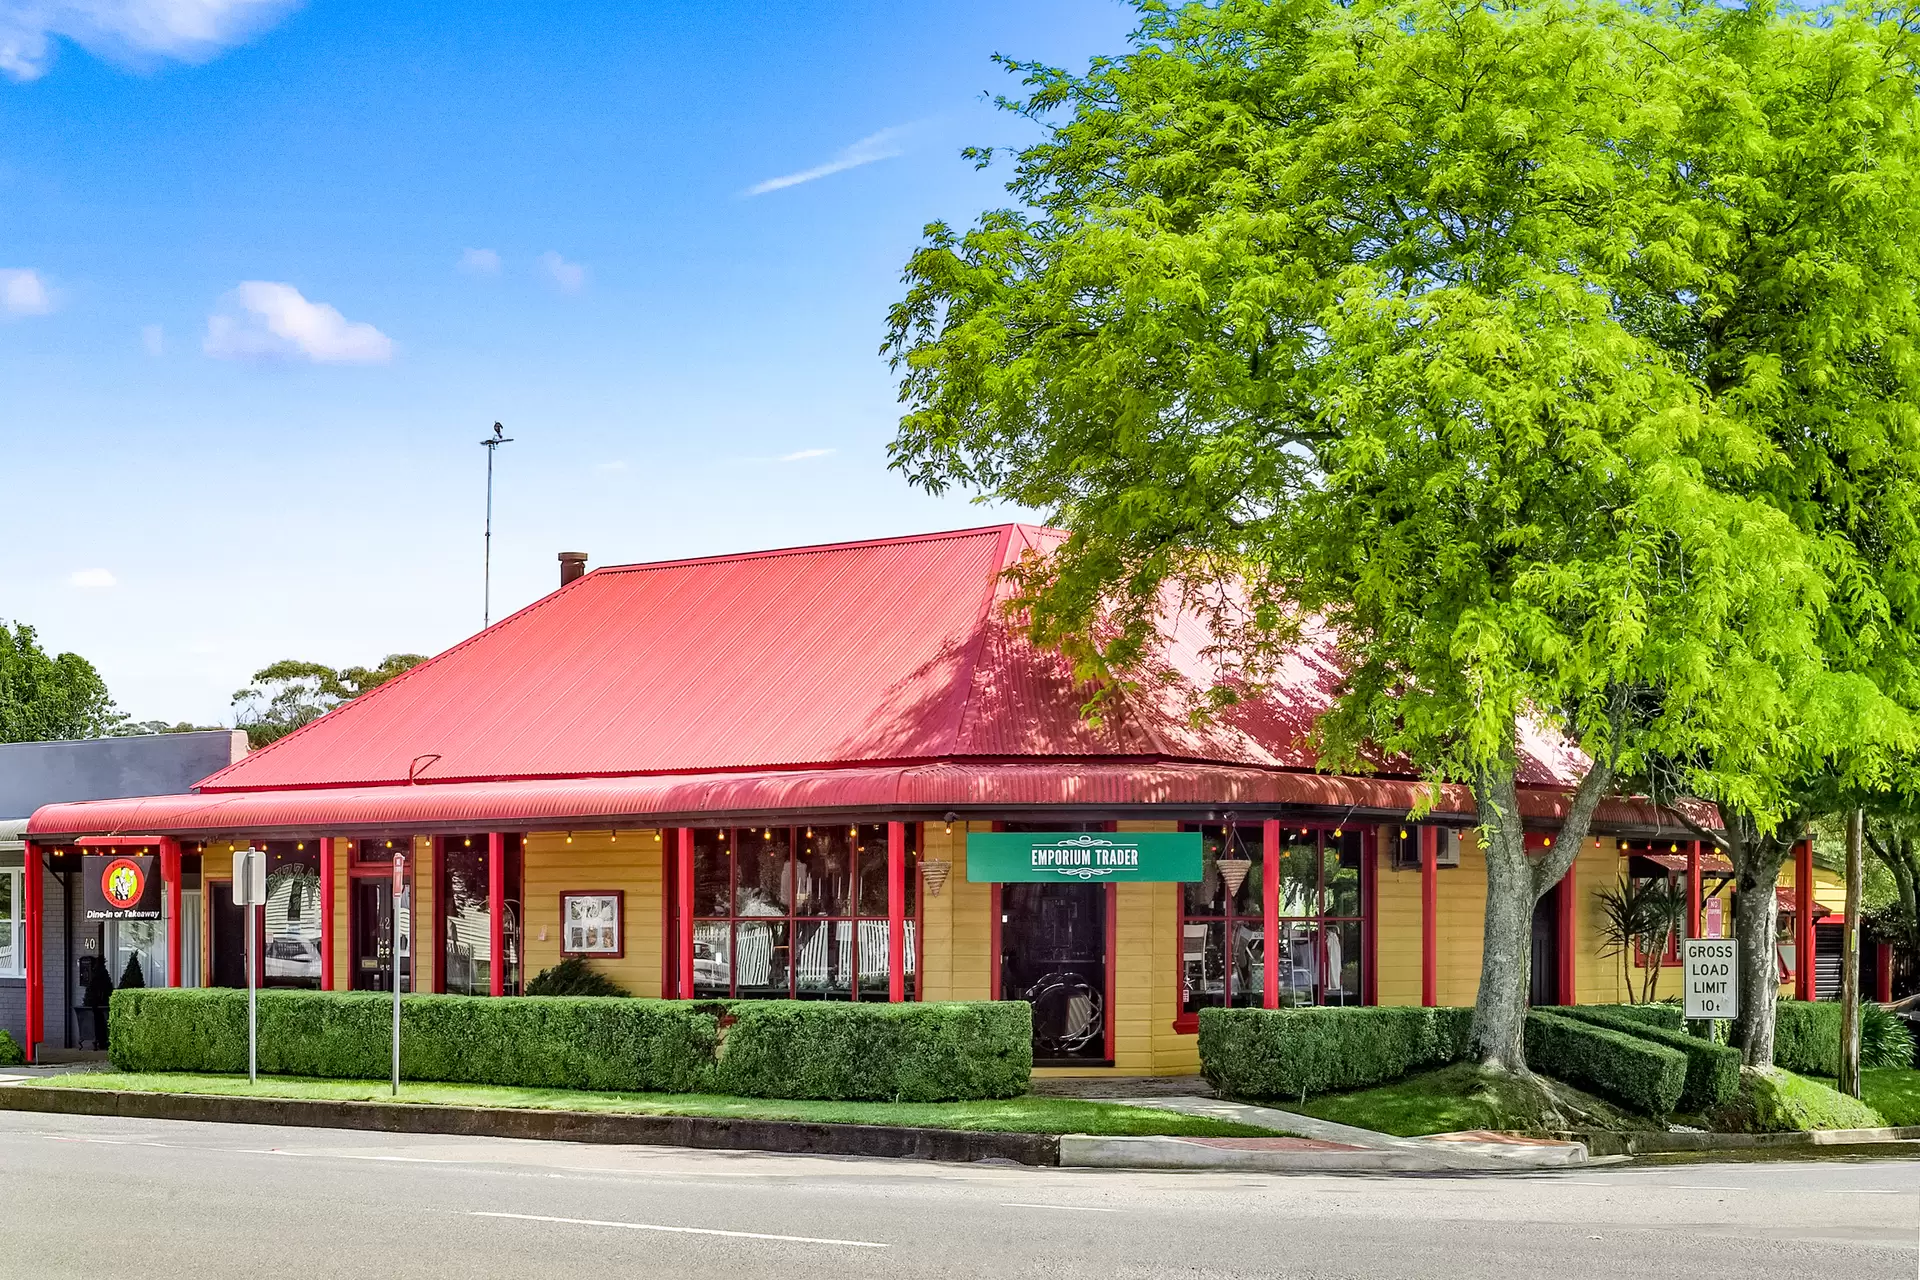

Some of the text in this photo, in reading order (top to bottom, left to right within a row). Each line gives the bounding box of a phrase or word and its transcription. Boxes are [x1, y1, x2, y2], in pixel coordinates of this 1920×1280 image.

[1031, 849, 1138, 866] EMPORIUM TRADER
[266, 862, 318, 899] PIZZA
[87, 910, 113, 918] Dine-in
[124, 910, 159, 919] Takeaway
[379, 917, 391, 930] 42
[84, 938, 96, 949] 40
[1688, 946, 1733, 958] GROSS
[1692, 964, 1729, 976] LOAD
[1694, 982, 1727, 994] LIMIT
